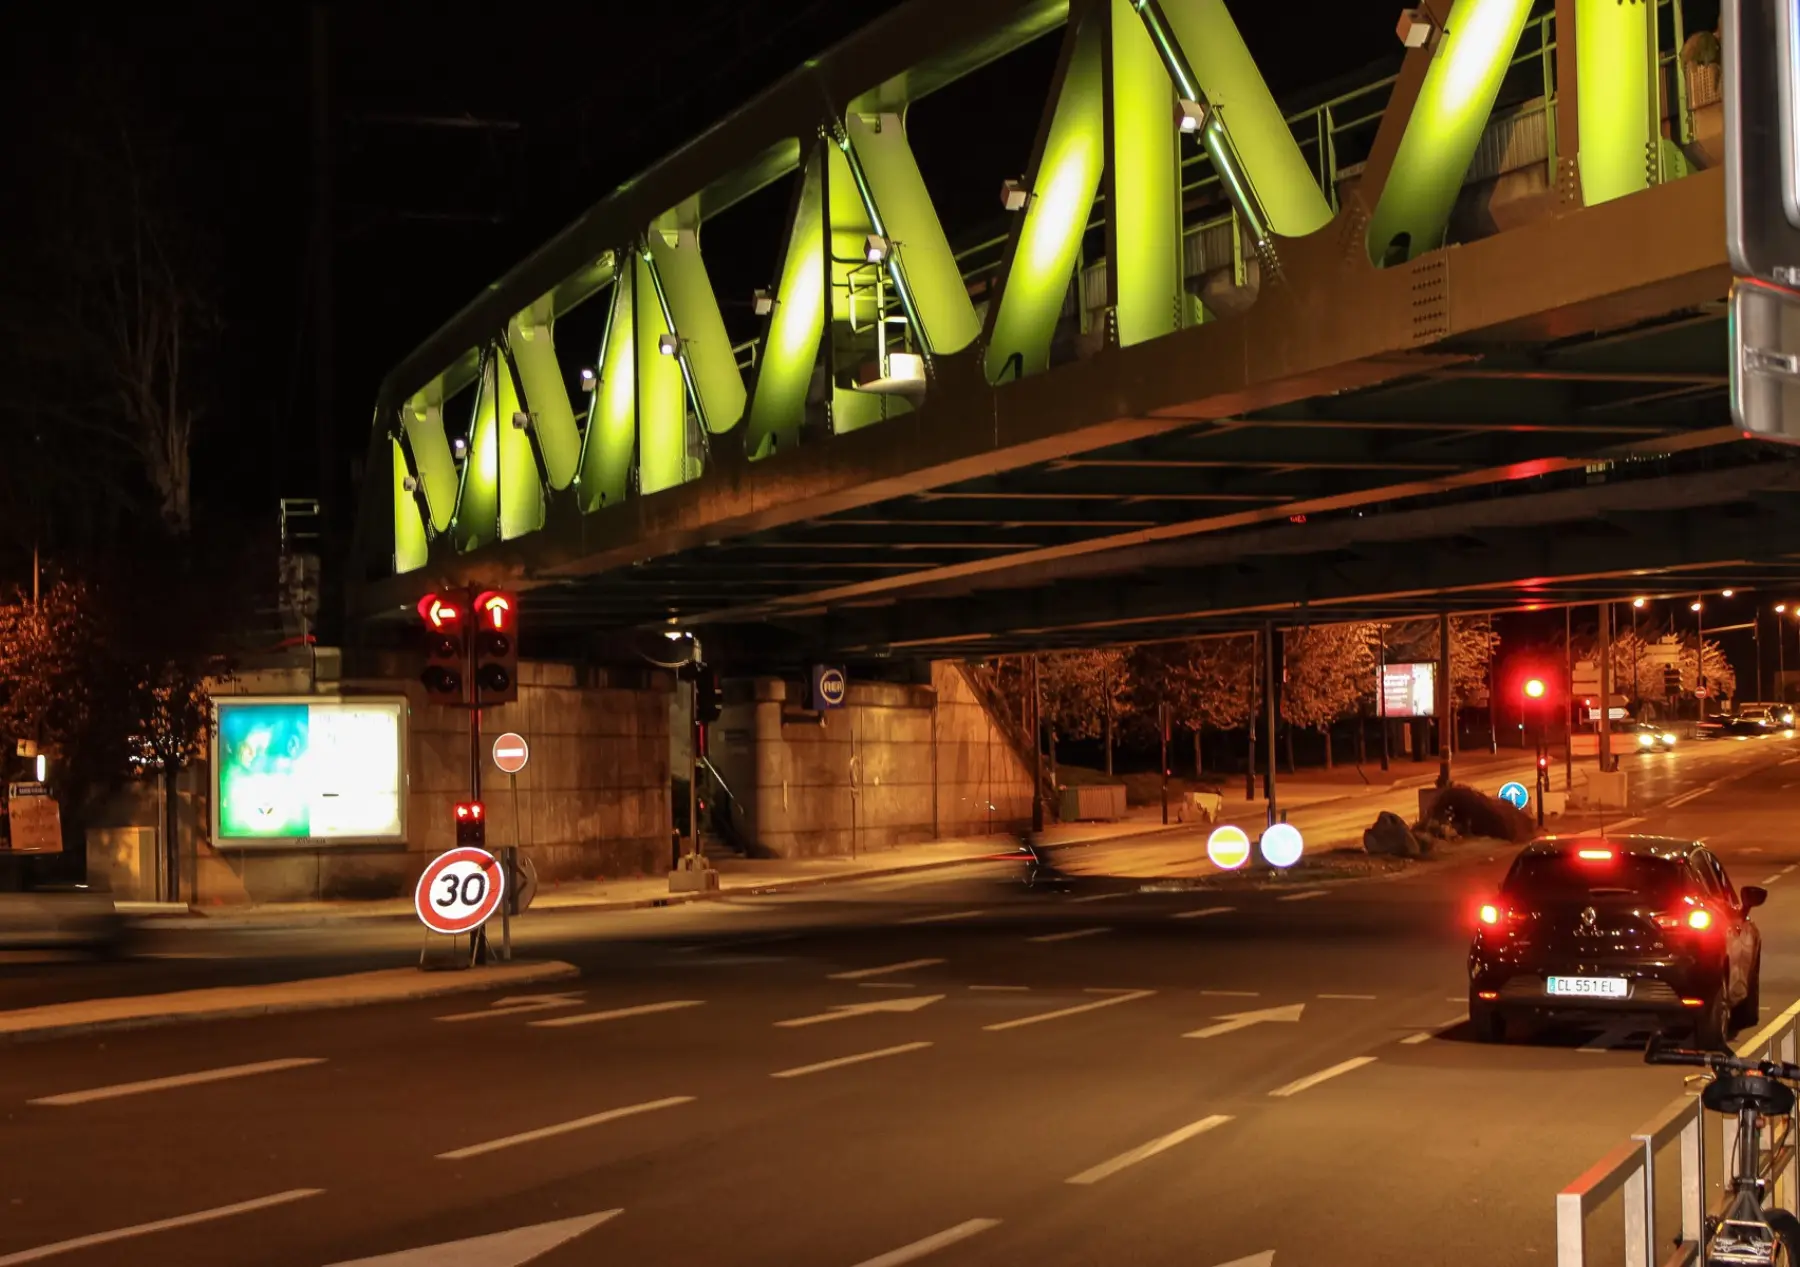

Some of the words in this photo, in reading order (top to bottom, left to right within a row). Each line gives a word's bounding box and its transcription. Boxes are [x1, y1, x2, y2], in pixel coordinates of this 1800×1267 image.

[436, 873, 486, 907] 30
[1557, 979, 1571, 992] CL
[1576, 979, 1597, 992] 551
[1601, 980, 1615, 993] EL
